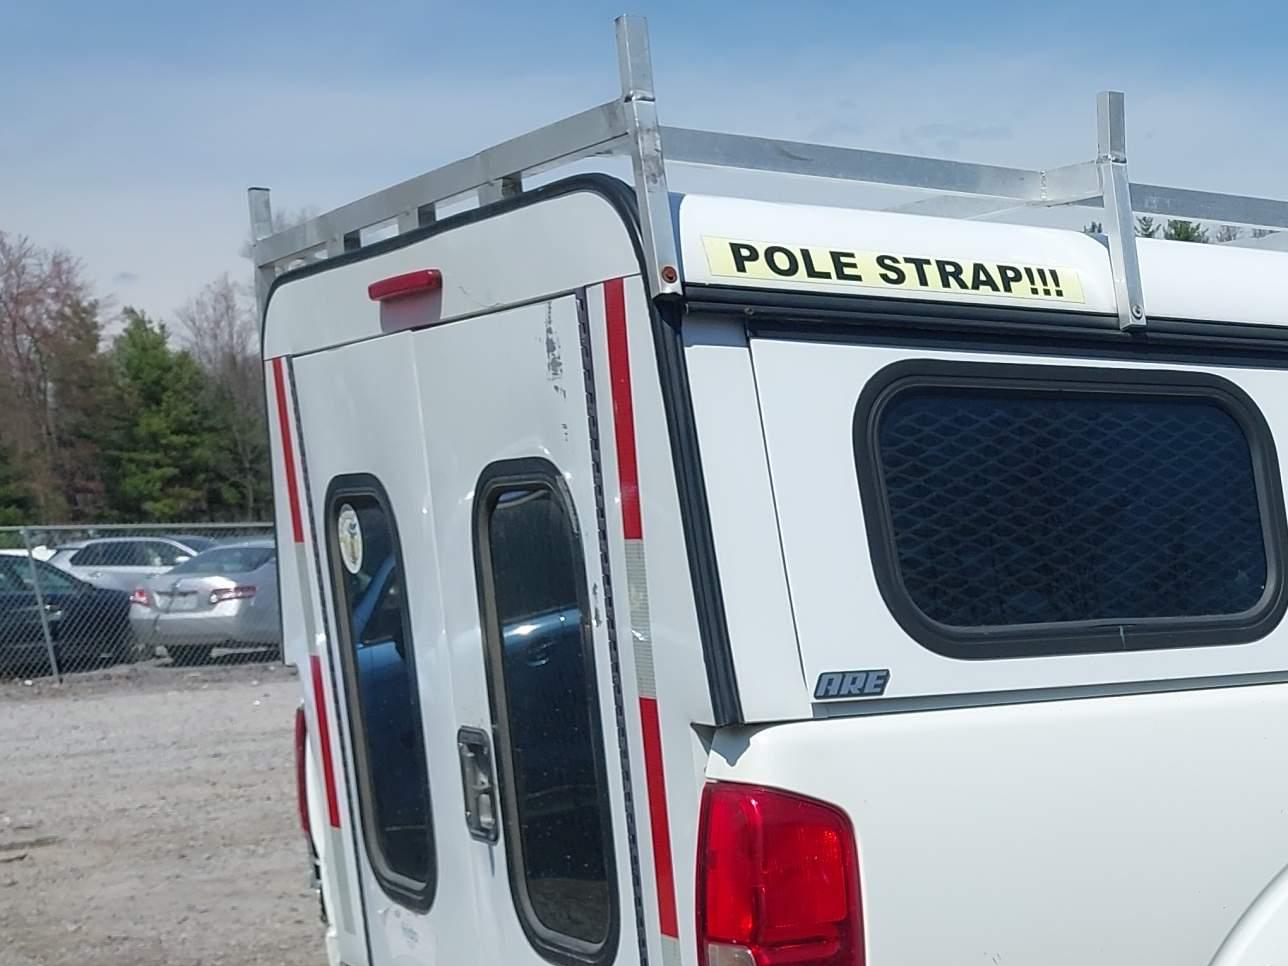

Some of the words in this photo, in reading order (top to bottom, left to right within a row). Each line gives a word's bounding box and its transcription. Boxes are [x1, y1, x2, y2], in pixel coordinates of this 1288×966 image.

[729, 242, 863, 282] POLE
[876, 254, 1064, 298] STRAP!!!
[814, 669, 890, 700] ARE
